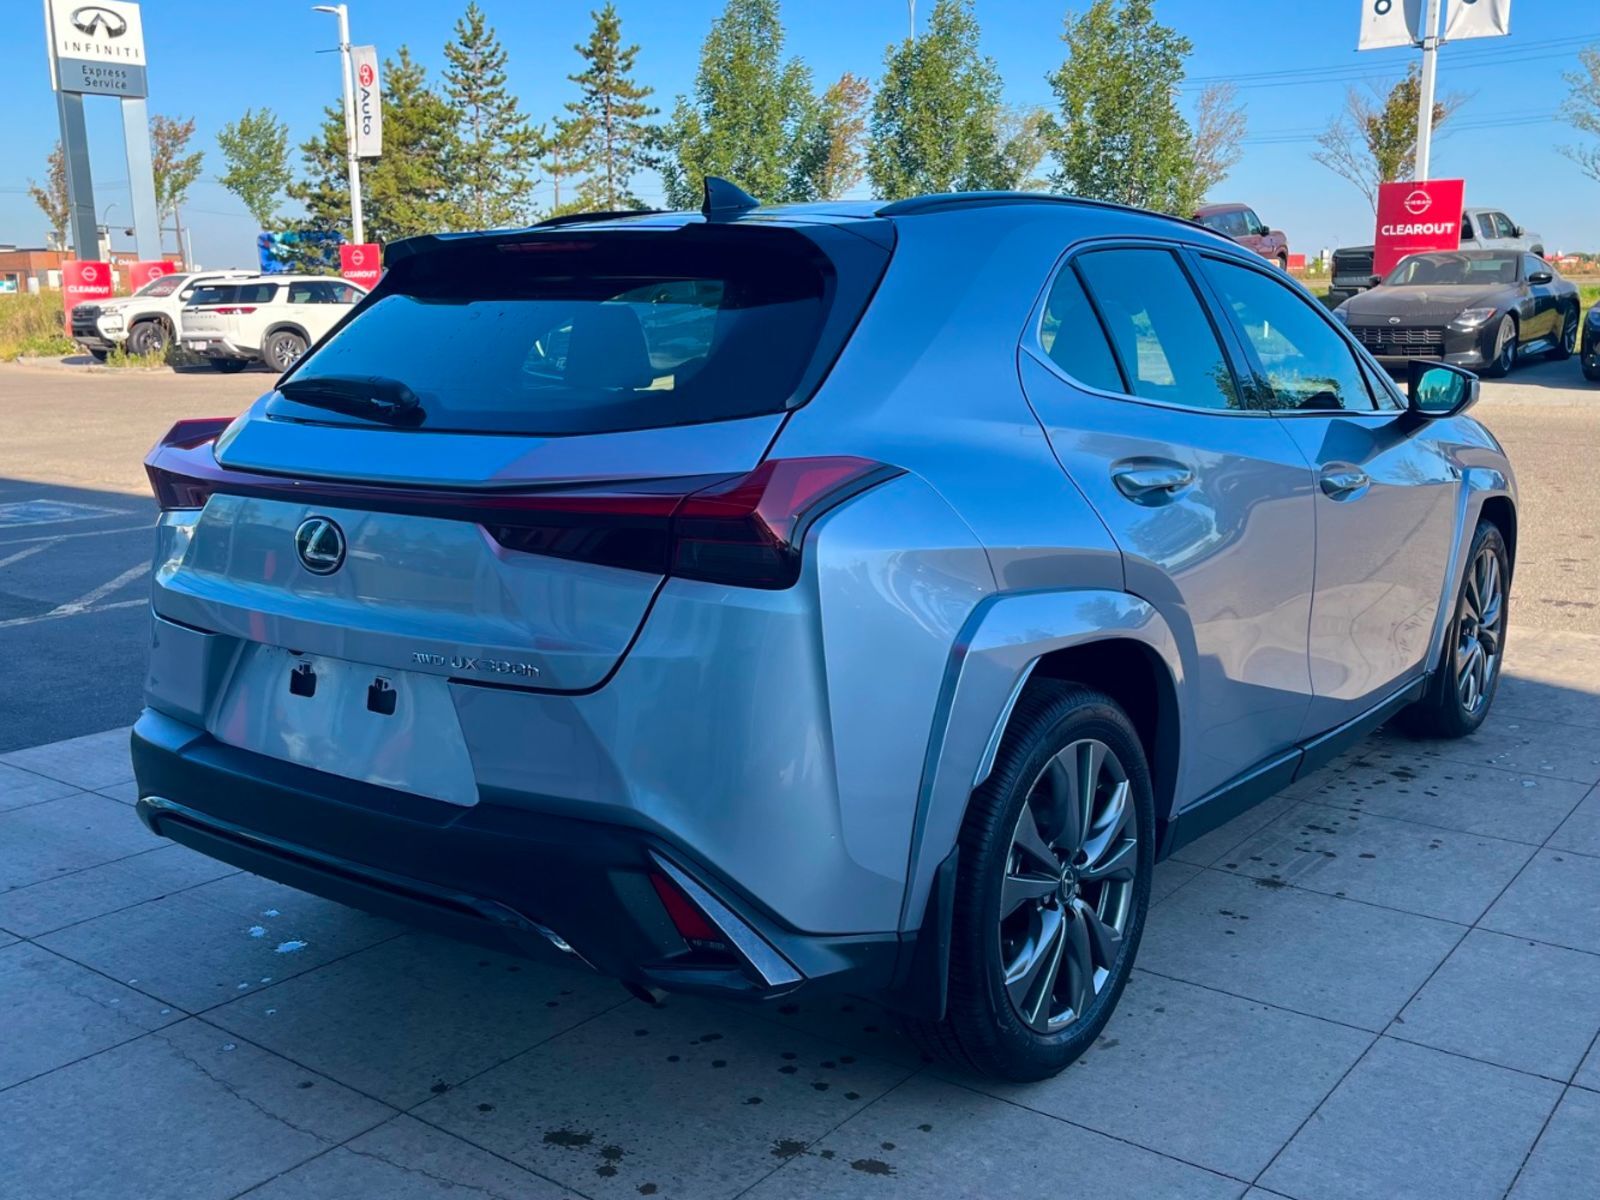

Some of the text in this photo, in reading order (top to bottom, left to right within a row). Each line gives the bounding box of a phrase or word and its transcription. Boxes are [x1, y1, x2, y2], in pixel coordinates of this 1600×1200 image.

[64, 41, 139, 58] INFINITI
[82, 65, 127, 79] Express
[84, 77, 127, 90] Service
[361, 87, 372, 136] Auto
[1381, 222, 1455, 236] CLEAROUT
[343, 270, 378, 278] CLEAROUT
[67, 285, 109, 294] CLEAROUT
